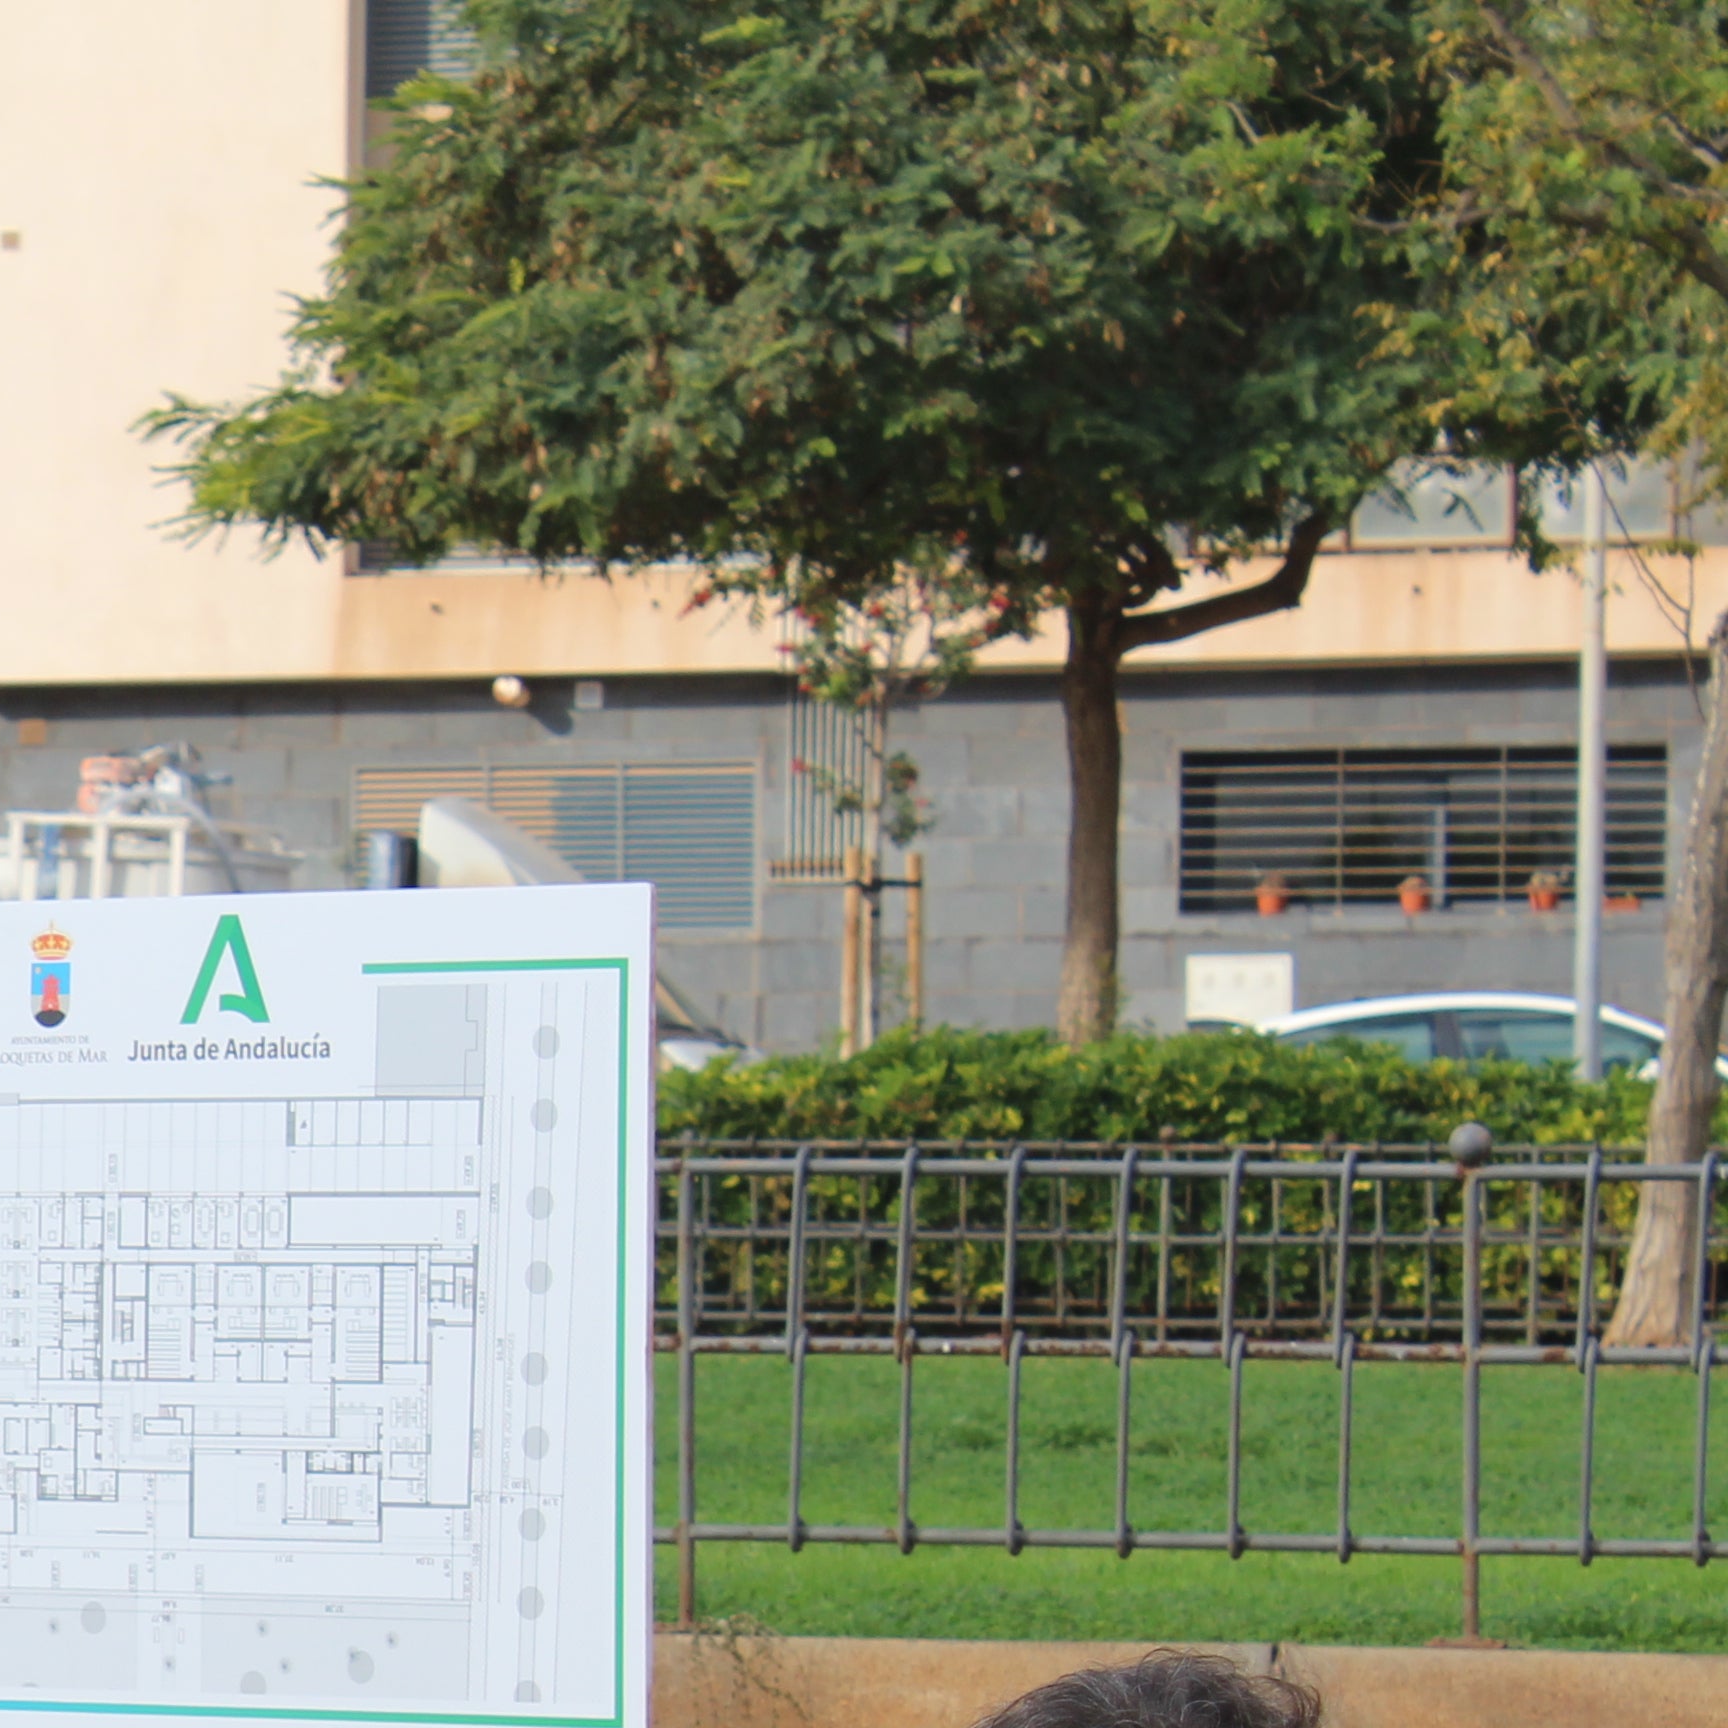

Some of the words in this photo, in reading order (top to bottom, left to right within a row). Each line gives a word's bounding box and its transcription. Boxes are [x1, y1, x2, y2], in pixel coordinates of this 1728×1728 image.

[59, 1050, 74, 1064] DE
[78, 1049, 109, 1064] MAR
[127, 1040, 188, 1062] Junta
[193, 1037, 220, 1061] de
[224, 1032, 332, 1061] Andalucía
